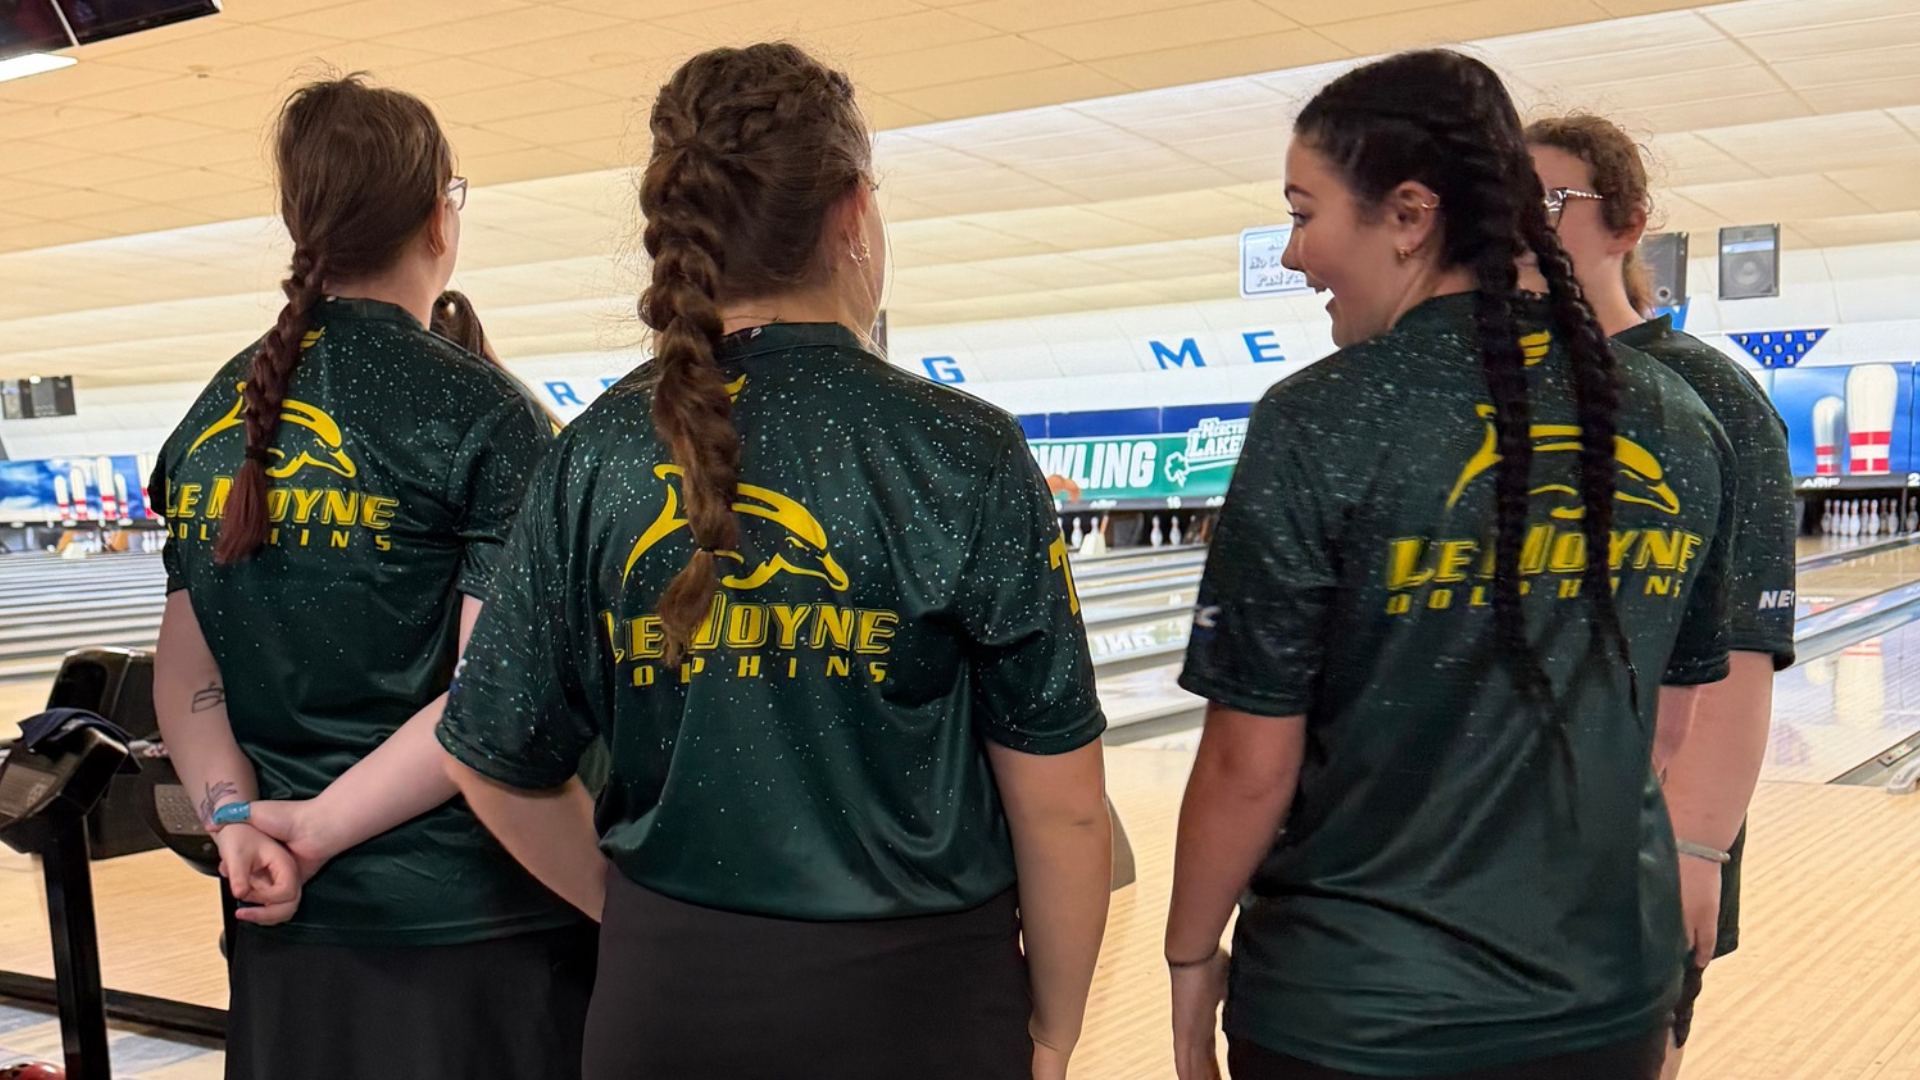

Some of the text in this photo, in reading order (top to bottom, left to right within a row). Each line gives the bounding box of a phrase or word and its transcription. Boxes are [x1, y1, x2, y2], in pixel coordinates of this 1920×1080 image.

[1029, 441, 1157, 490] WLING
[1908, 472, 1920, 487] 2
[1388, 537, 1476, 590] LE
